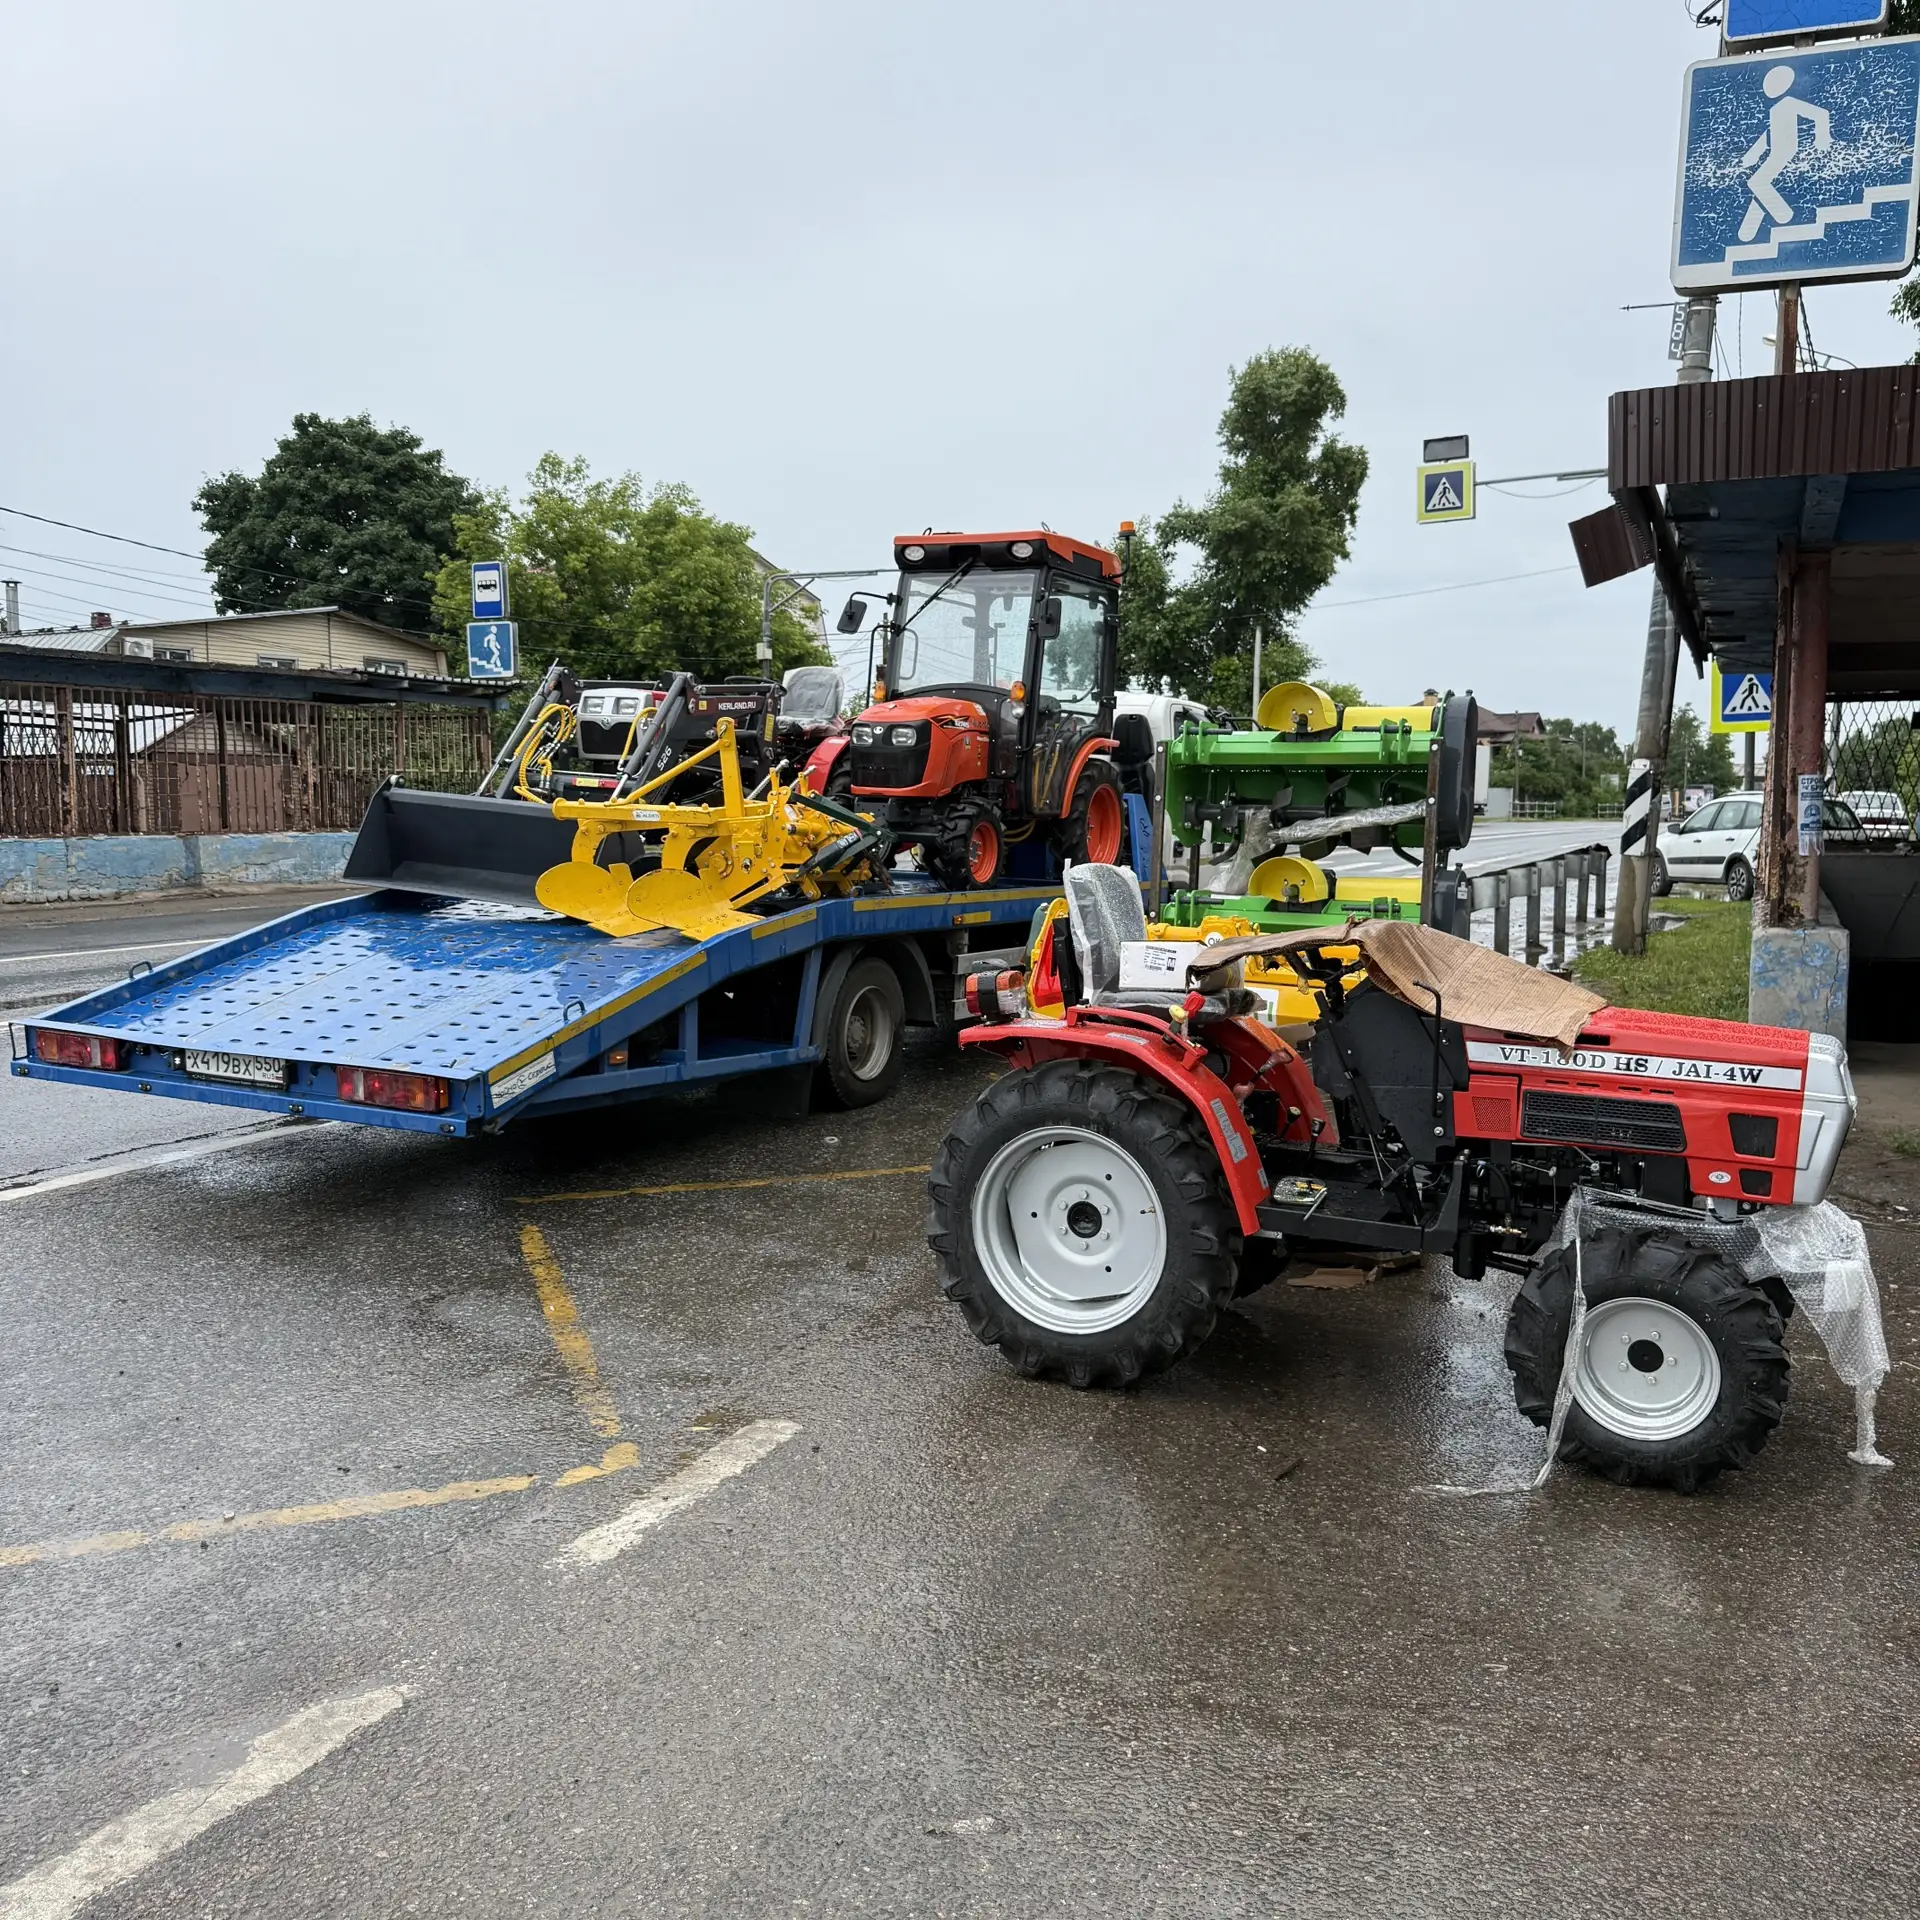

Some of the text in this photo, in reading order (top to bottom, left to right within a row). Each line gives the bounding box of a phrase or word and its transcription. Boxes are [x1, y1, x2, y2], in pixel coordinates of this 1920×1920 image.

[1671, 304, 1685, 358] 584
[718, 701, 757, 711] KERLAND.RU
[191, 1051, 280, 1076] Х419ВХ 550
[262, 1072, 276, 1080] RUS
[1613, 1056, 1649, 1073] HS
[1655, 1060, 1663, 1074] /
[1672, 1061, 1763, 1084] JAI-4W
